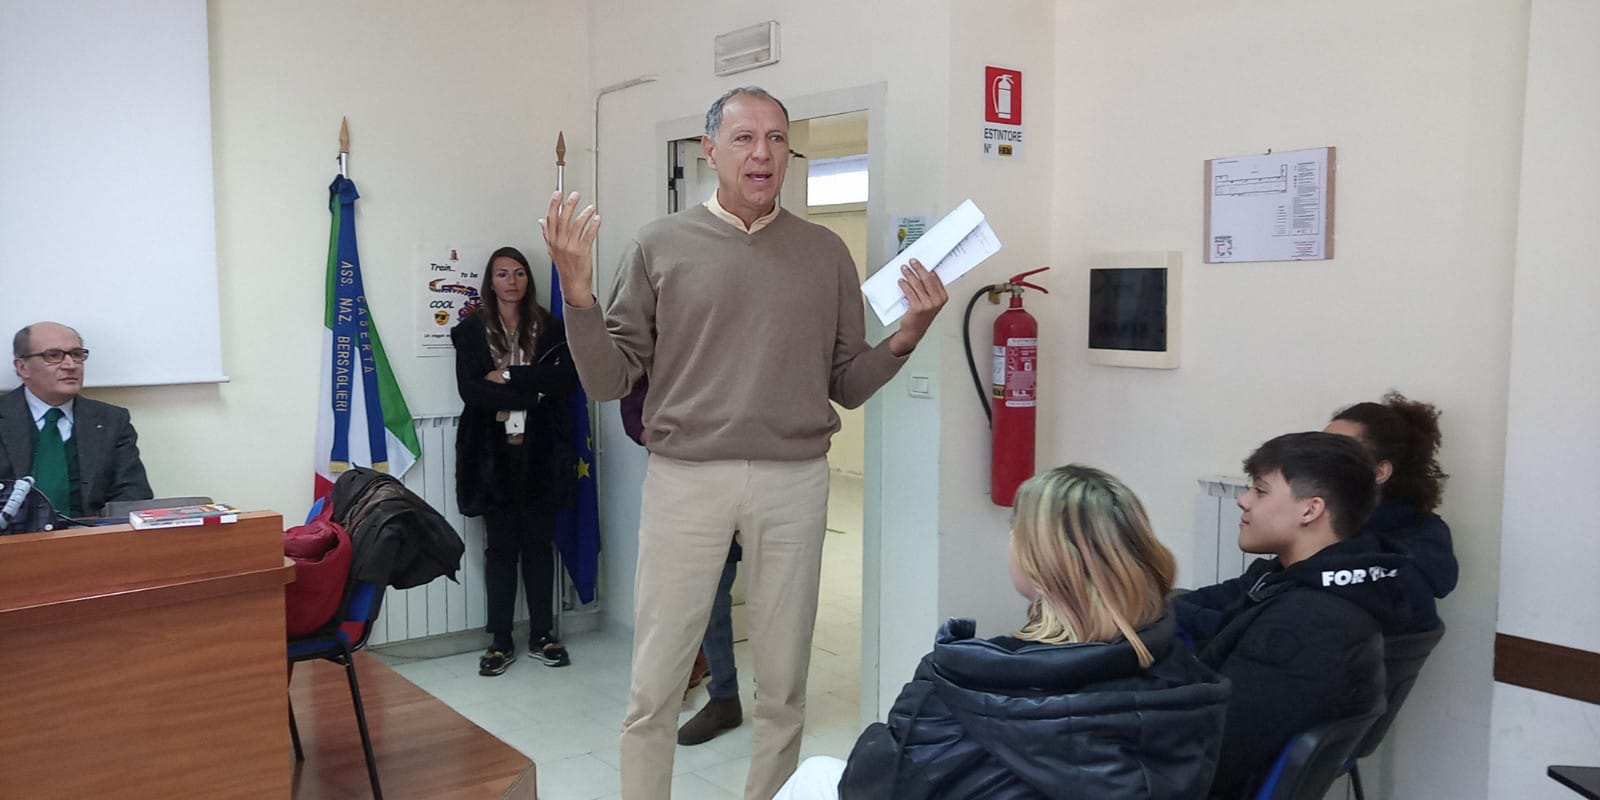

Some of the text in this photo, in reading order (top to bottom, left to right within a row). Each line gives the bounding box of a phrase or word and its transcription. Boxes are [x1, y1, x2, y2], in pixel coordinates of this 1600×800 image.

[984, 128, 1022, 142] ESTINTORE
[429, 300, 454, 309] COOL
[335, 260, 354, 412] ASS. NAZ. BERSAGLIERI
[357, 295, 375, 374] CASERTA
[1321, 569, 1367, 587] FOR
